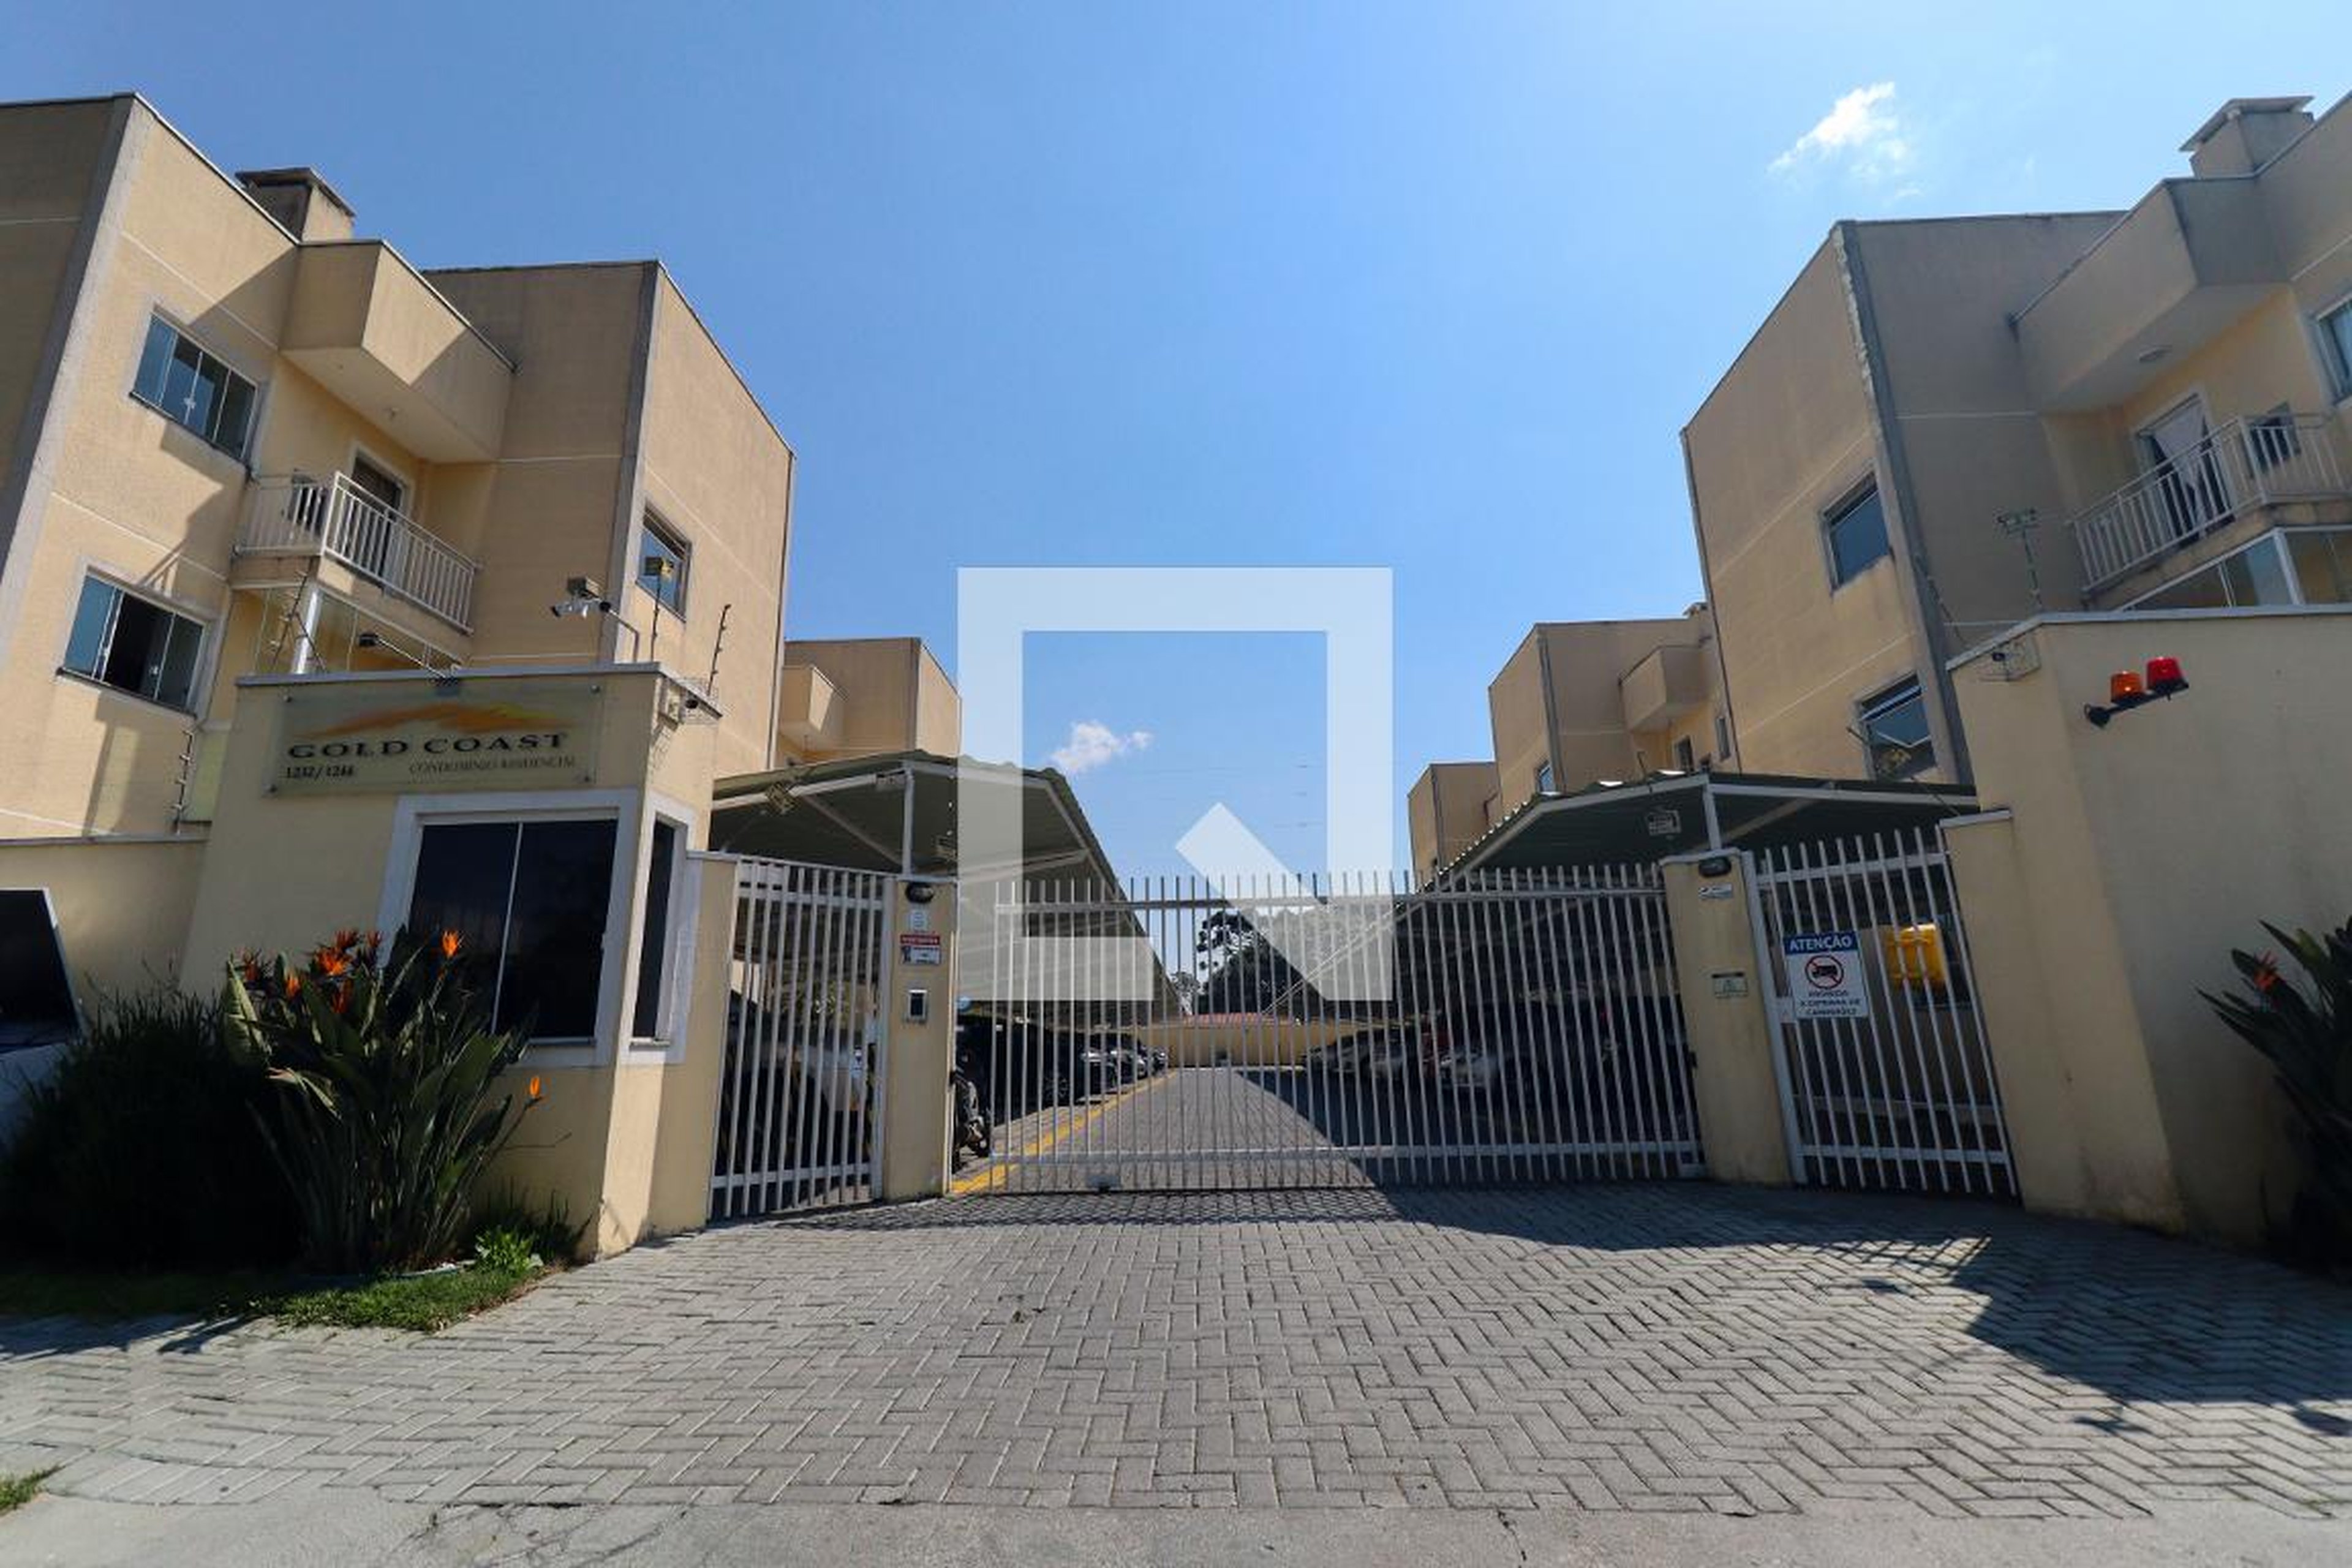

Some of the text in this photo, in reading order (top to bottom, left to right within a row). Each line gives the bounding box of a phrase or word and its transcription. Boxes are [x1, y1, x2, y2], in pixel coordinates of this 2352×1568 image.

[288, 734, 567, 759] GOLD COAST
[1790, 933, 1852, 951] ATENÇÃO
